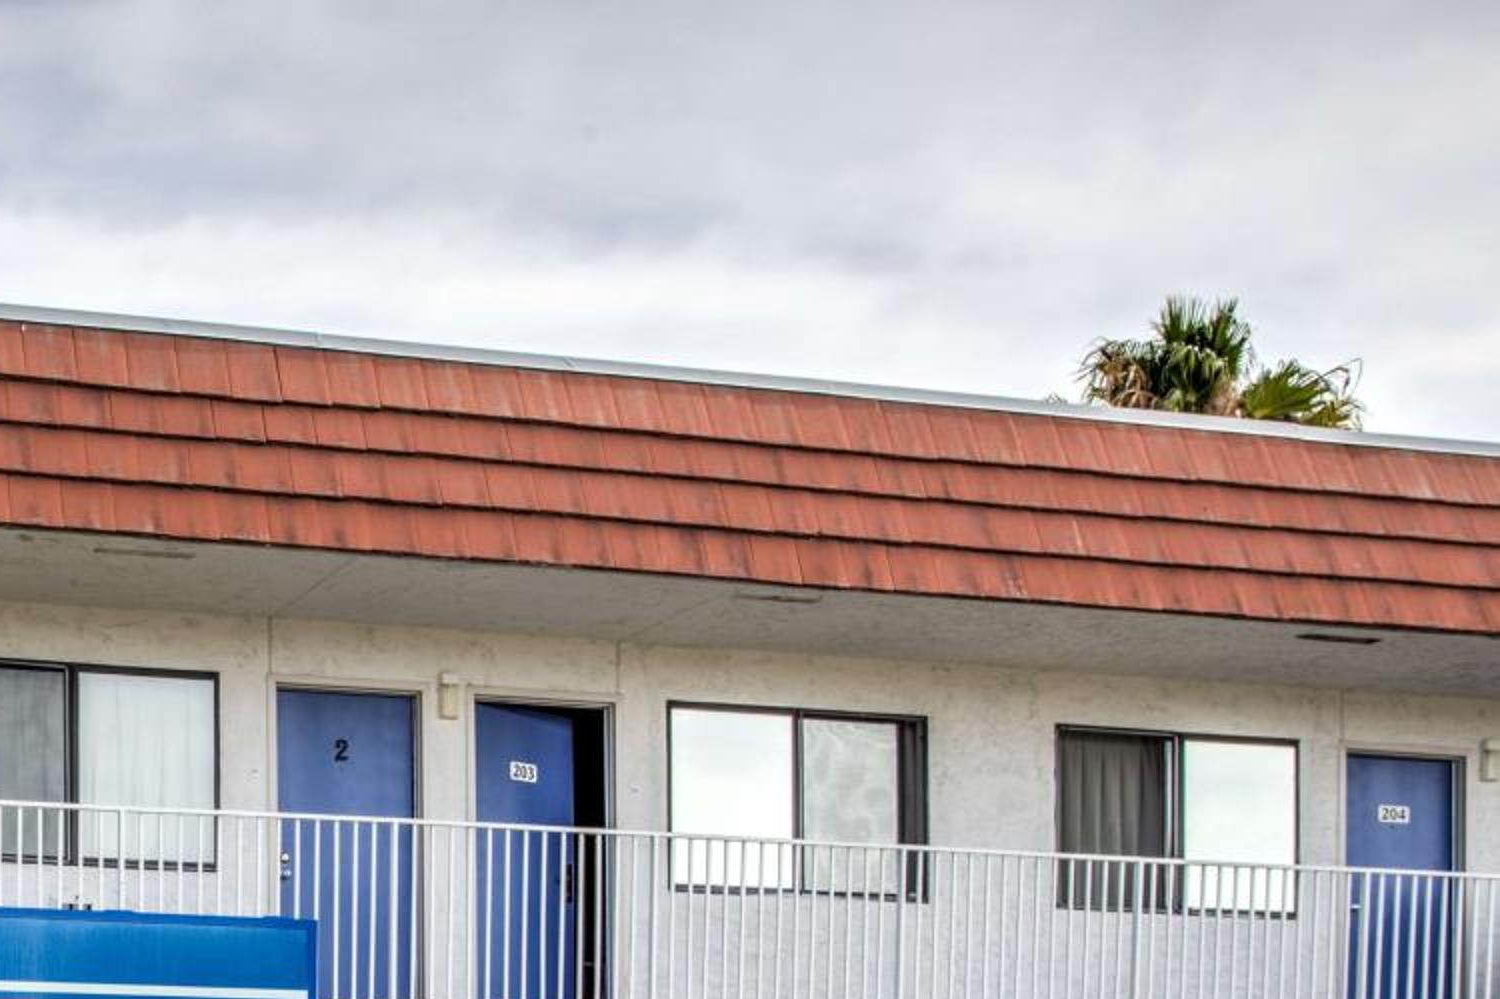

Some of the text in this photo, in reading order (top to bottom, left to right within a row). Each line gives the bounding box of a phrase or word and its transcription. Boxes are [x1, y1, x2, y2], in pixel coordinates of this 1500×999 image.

[333, 738, 350, 762] 2
[513, 763, 535, 781] 203
[1381, 806, 1406, 821] 204
